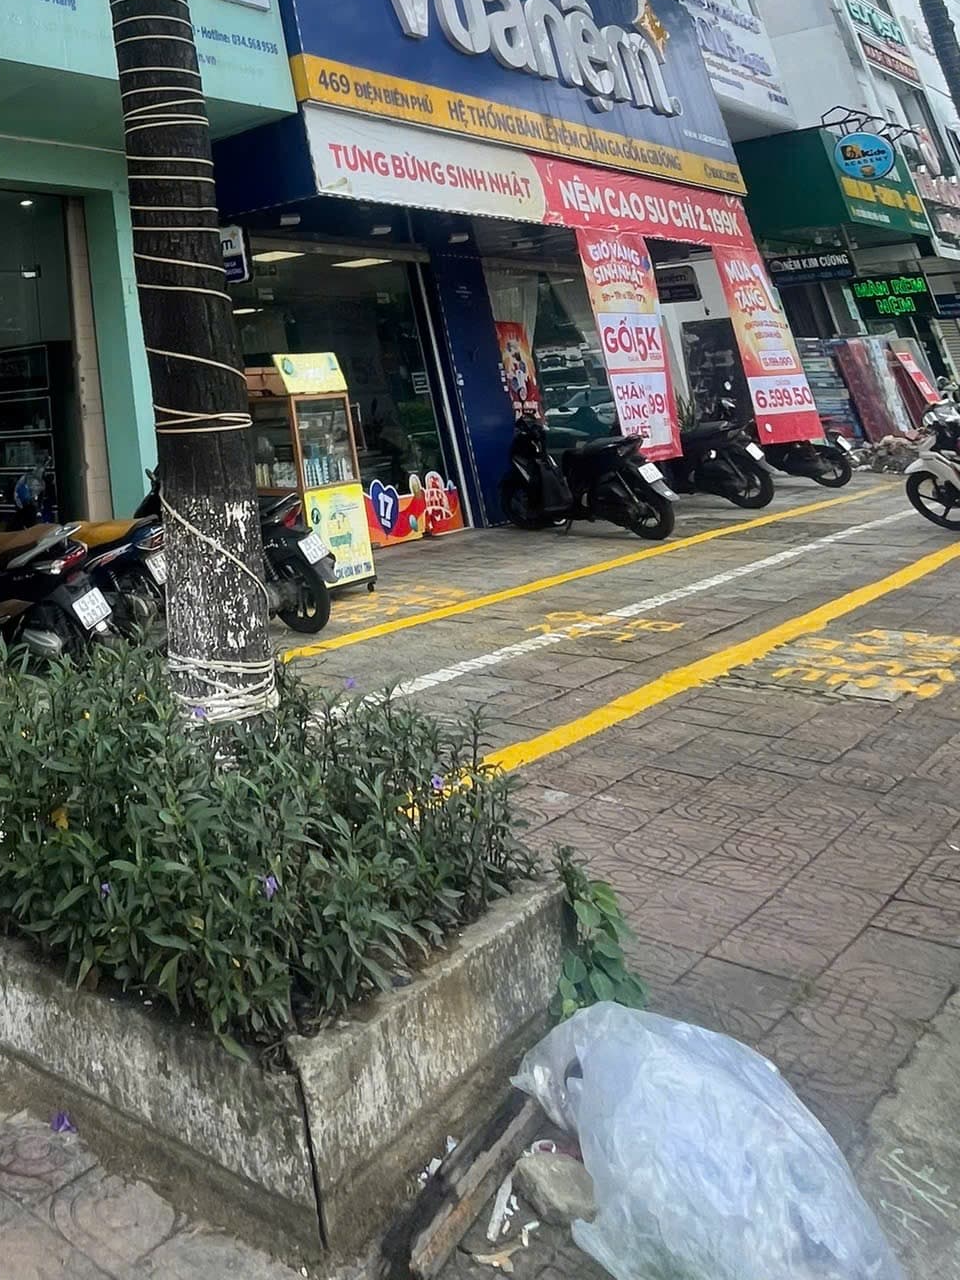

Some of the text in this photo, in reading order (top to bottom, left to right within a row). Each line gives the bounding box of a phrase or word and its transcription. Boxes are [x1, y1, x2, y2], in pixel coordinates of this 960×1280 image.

[201, 26, 230, 43] Hotline:
[318, 69, 350, 95] 469
[354, 81, 383, 105] ĐIỆN
[383, 88, 410, 108] BIÊN
[411, 94, 433, 114] PHỦ
[447, 99, 468, 128] HỆ
[467, 104, 517, 134] THỐNG
[515, 115, 542, 140] BÁN
[607, 140, 624, 158] GA
[391, 151, 446, 185] BỪNG
[446, 164, 488, 192] SINH
[487, 171, 530, 204] NHẬT
[558, 175, 605, 221] NỆM
[604, 187, 645, 222] CAO
[644, 194, 669, 225] SU
[668, 196, 697, 230] CHỈ
[695, 206, 744, 237] 2.199K
[593, 263, 618, 284] SINH
[723, 260, 754, 284] MUA
[603, 316, 638, 354] GỐI
